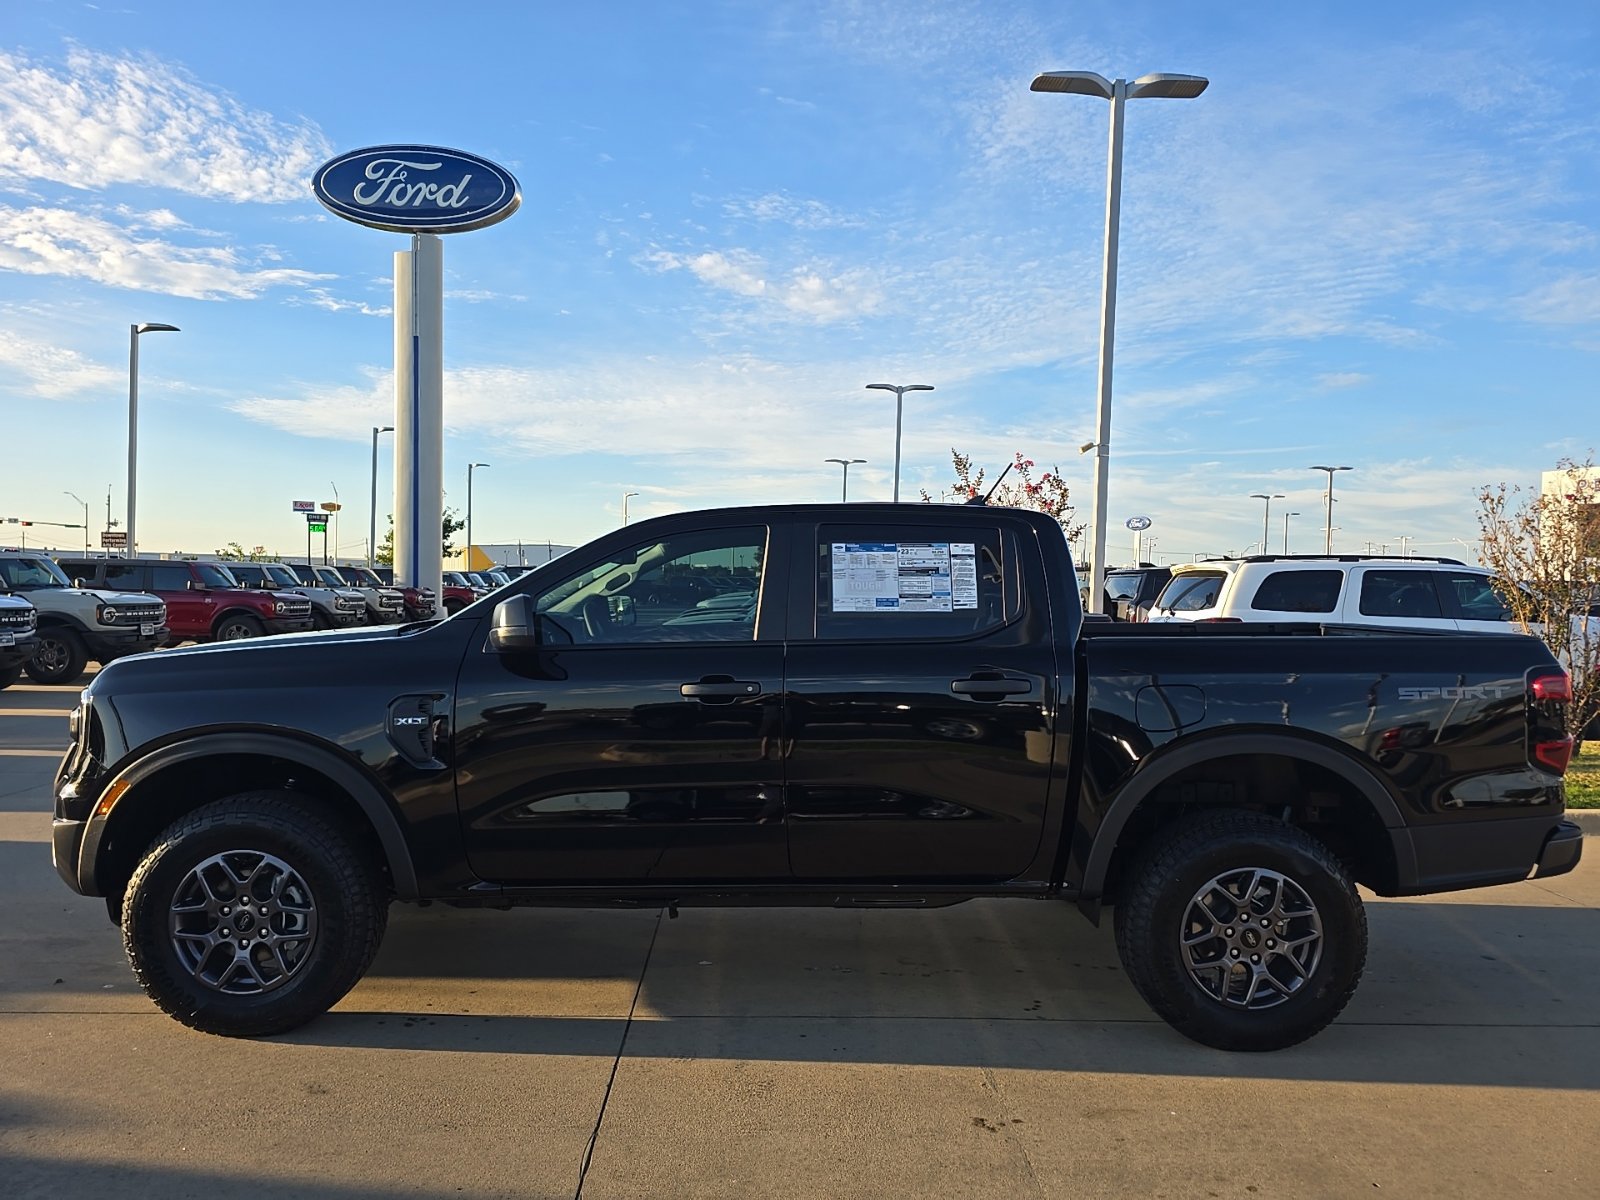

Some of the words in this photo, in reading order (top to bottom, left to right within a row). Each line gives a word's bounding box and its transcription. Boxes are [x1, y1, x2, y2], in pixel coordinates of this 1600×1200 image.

[353, 158, 473, 208] Ford
[1398, 686, 1511, 700] SPORT
[395, 717, 426, 725] XLT
